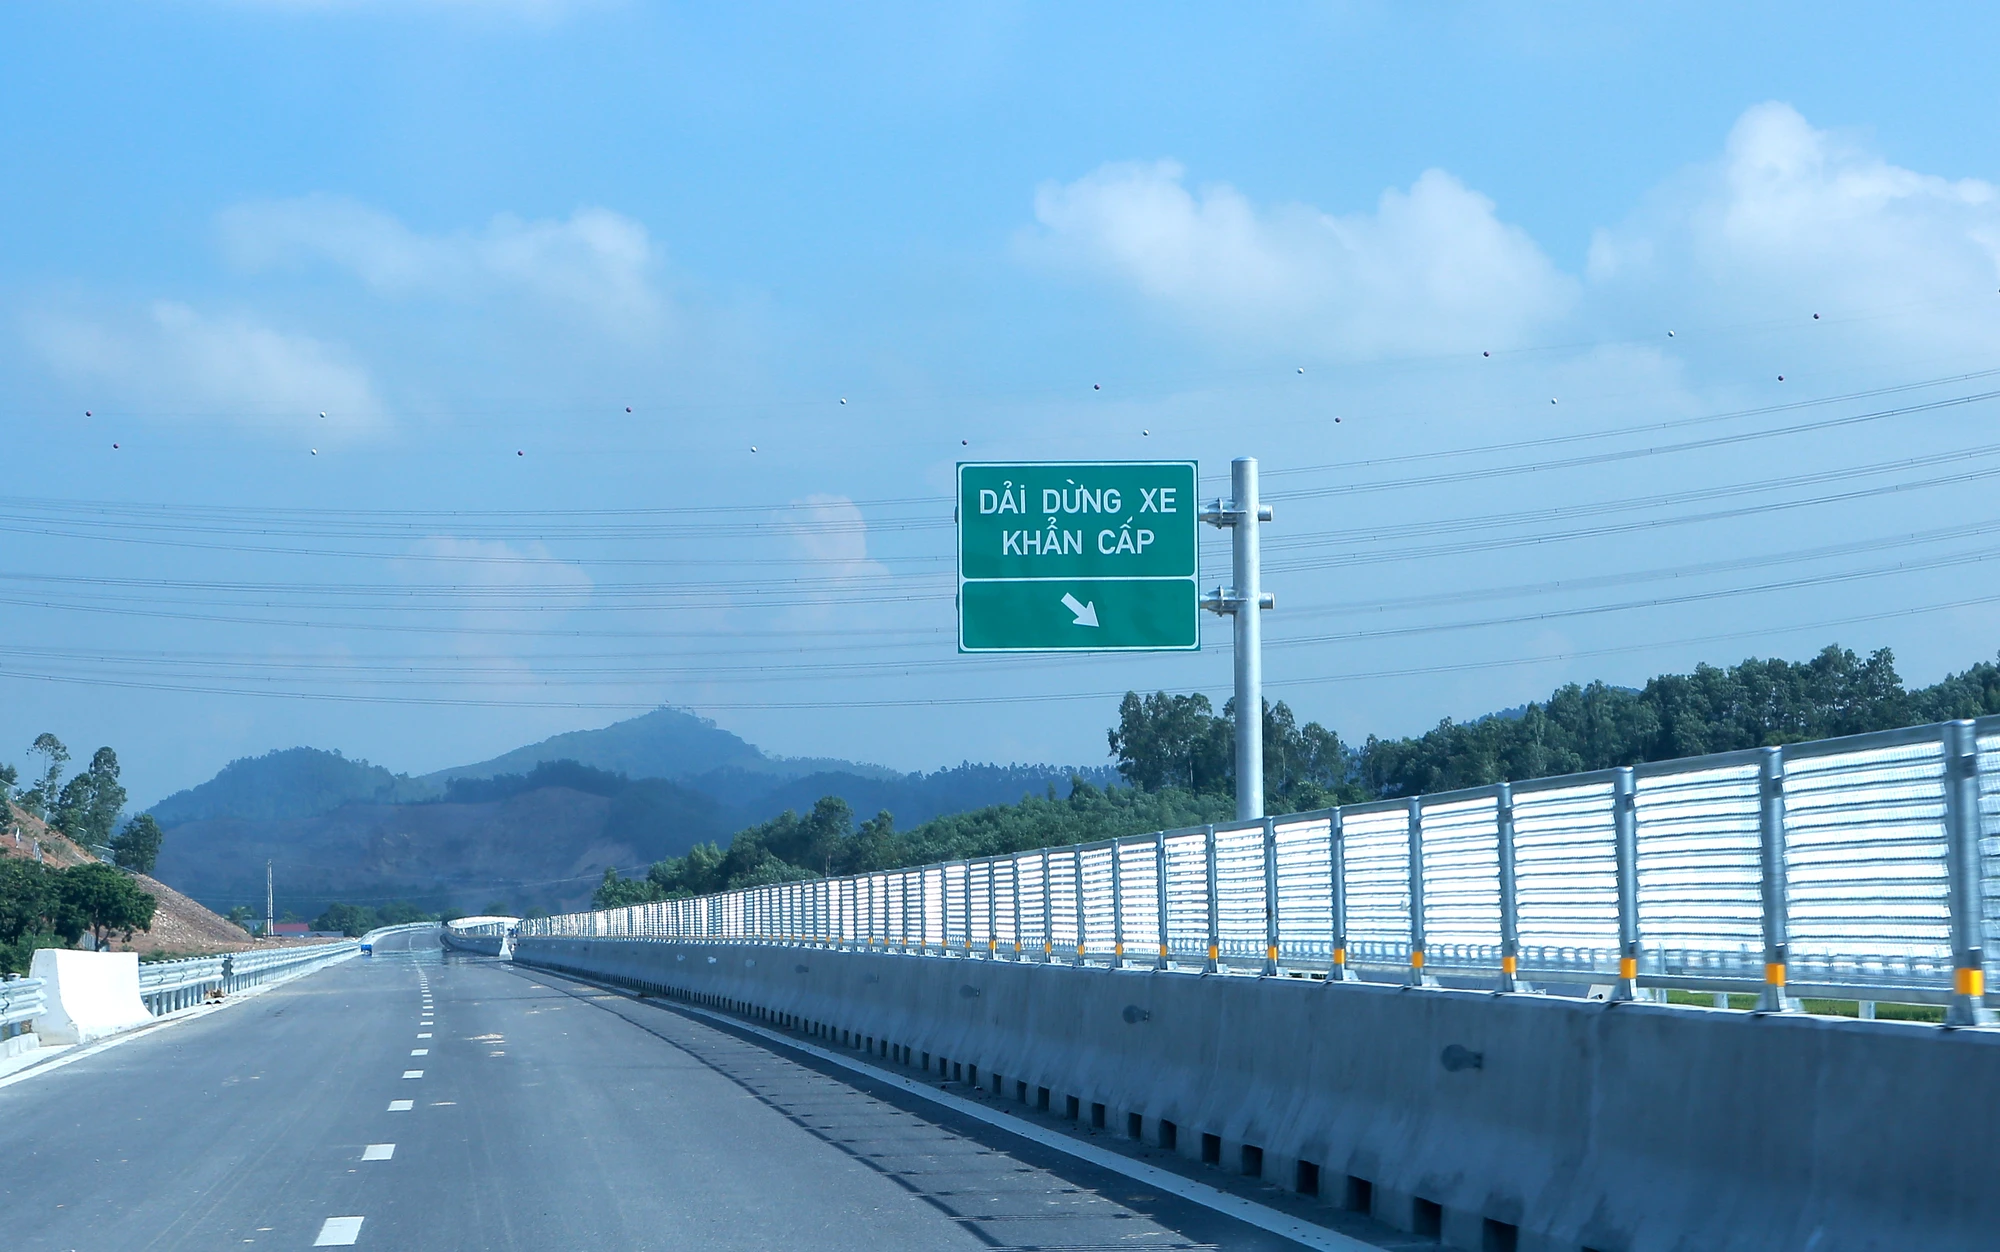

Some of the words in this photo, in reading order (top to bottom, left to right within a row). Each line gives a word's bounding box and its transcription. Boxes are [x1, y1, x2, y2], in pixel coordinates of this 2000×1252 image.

[1042, 479, 1122, 514] DỪNG
[1139, 488, 1177, 513] XE
[1002, 516, 1083, 555] KHẨN
[1098, 516, 1155, 555] CẤP
